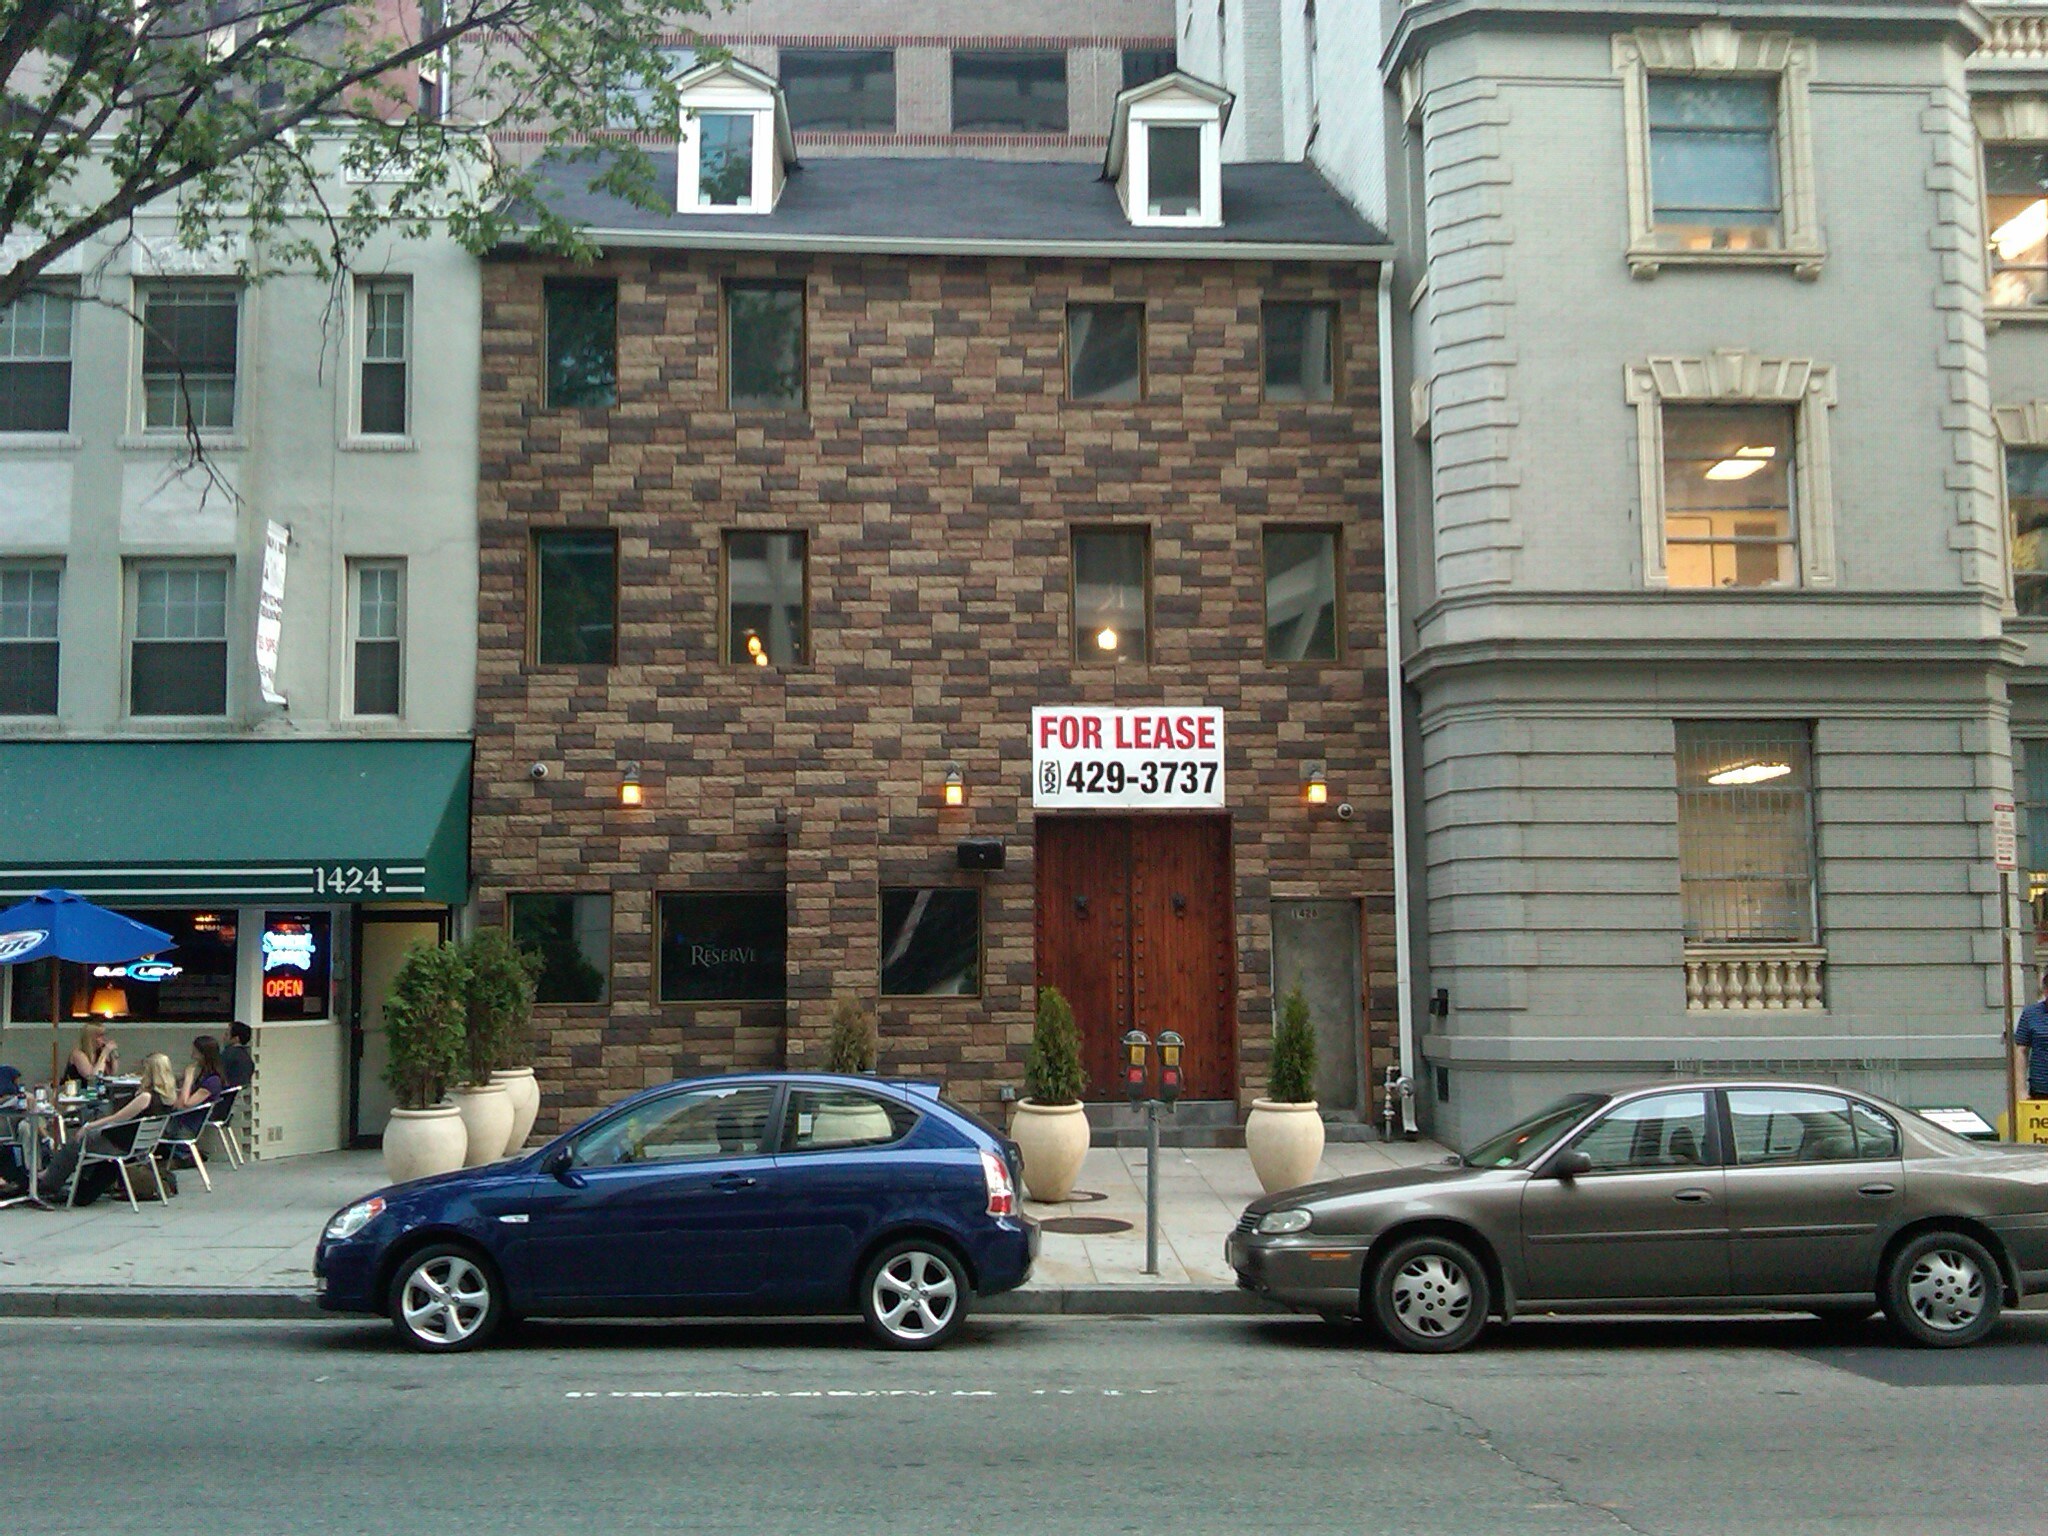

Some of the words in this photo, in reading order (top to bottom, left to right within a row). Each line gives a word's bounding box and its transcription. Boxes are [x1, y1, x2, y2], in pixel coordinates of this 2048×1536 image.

[1040, 715, 1102, 750] FOR
[1115, 715, 1216, 750] LEASE
[1039, 759, 1062, 795] (202)
[1066, 760, 1219, 794] 429-3737
[315, 866, 383, 895] 1424
[266, 979, 303, 998] OPEN
